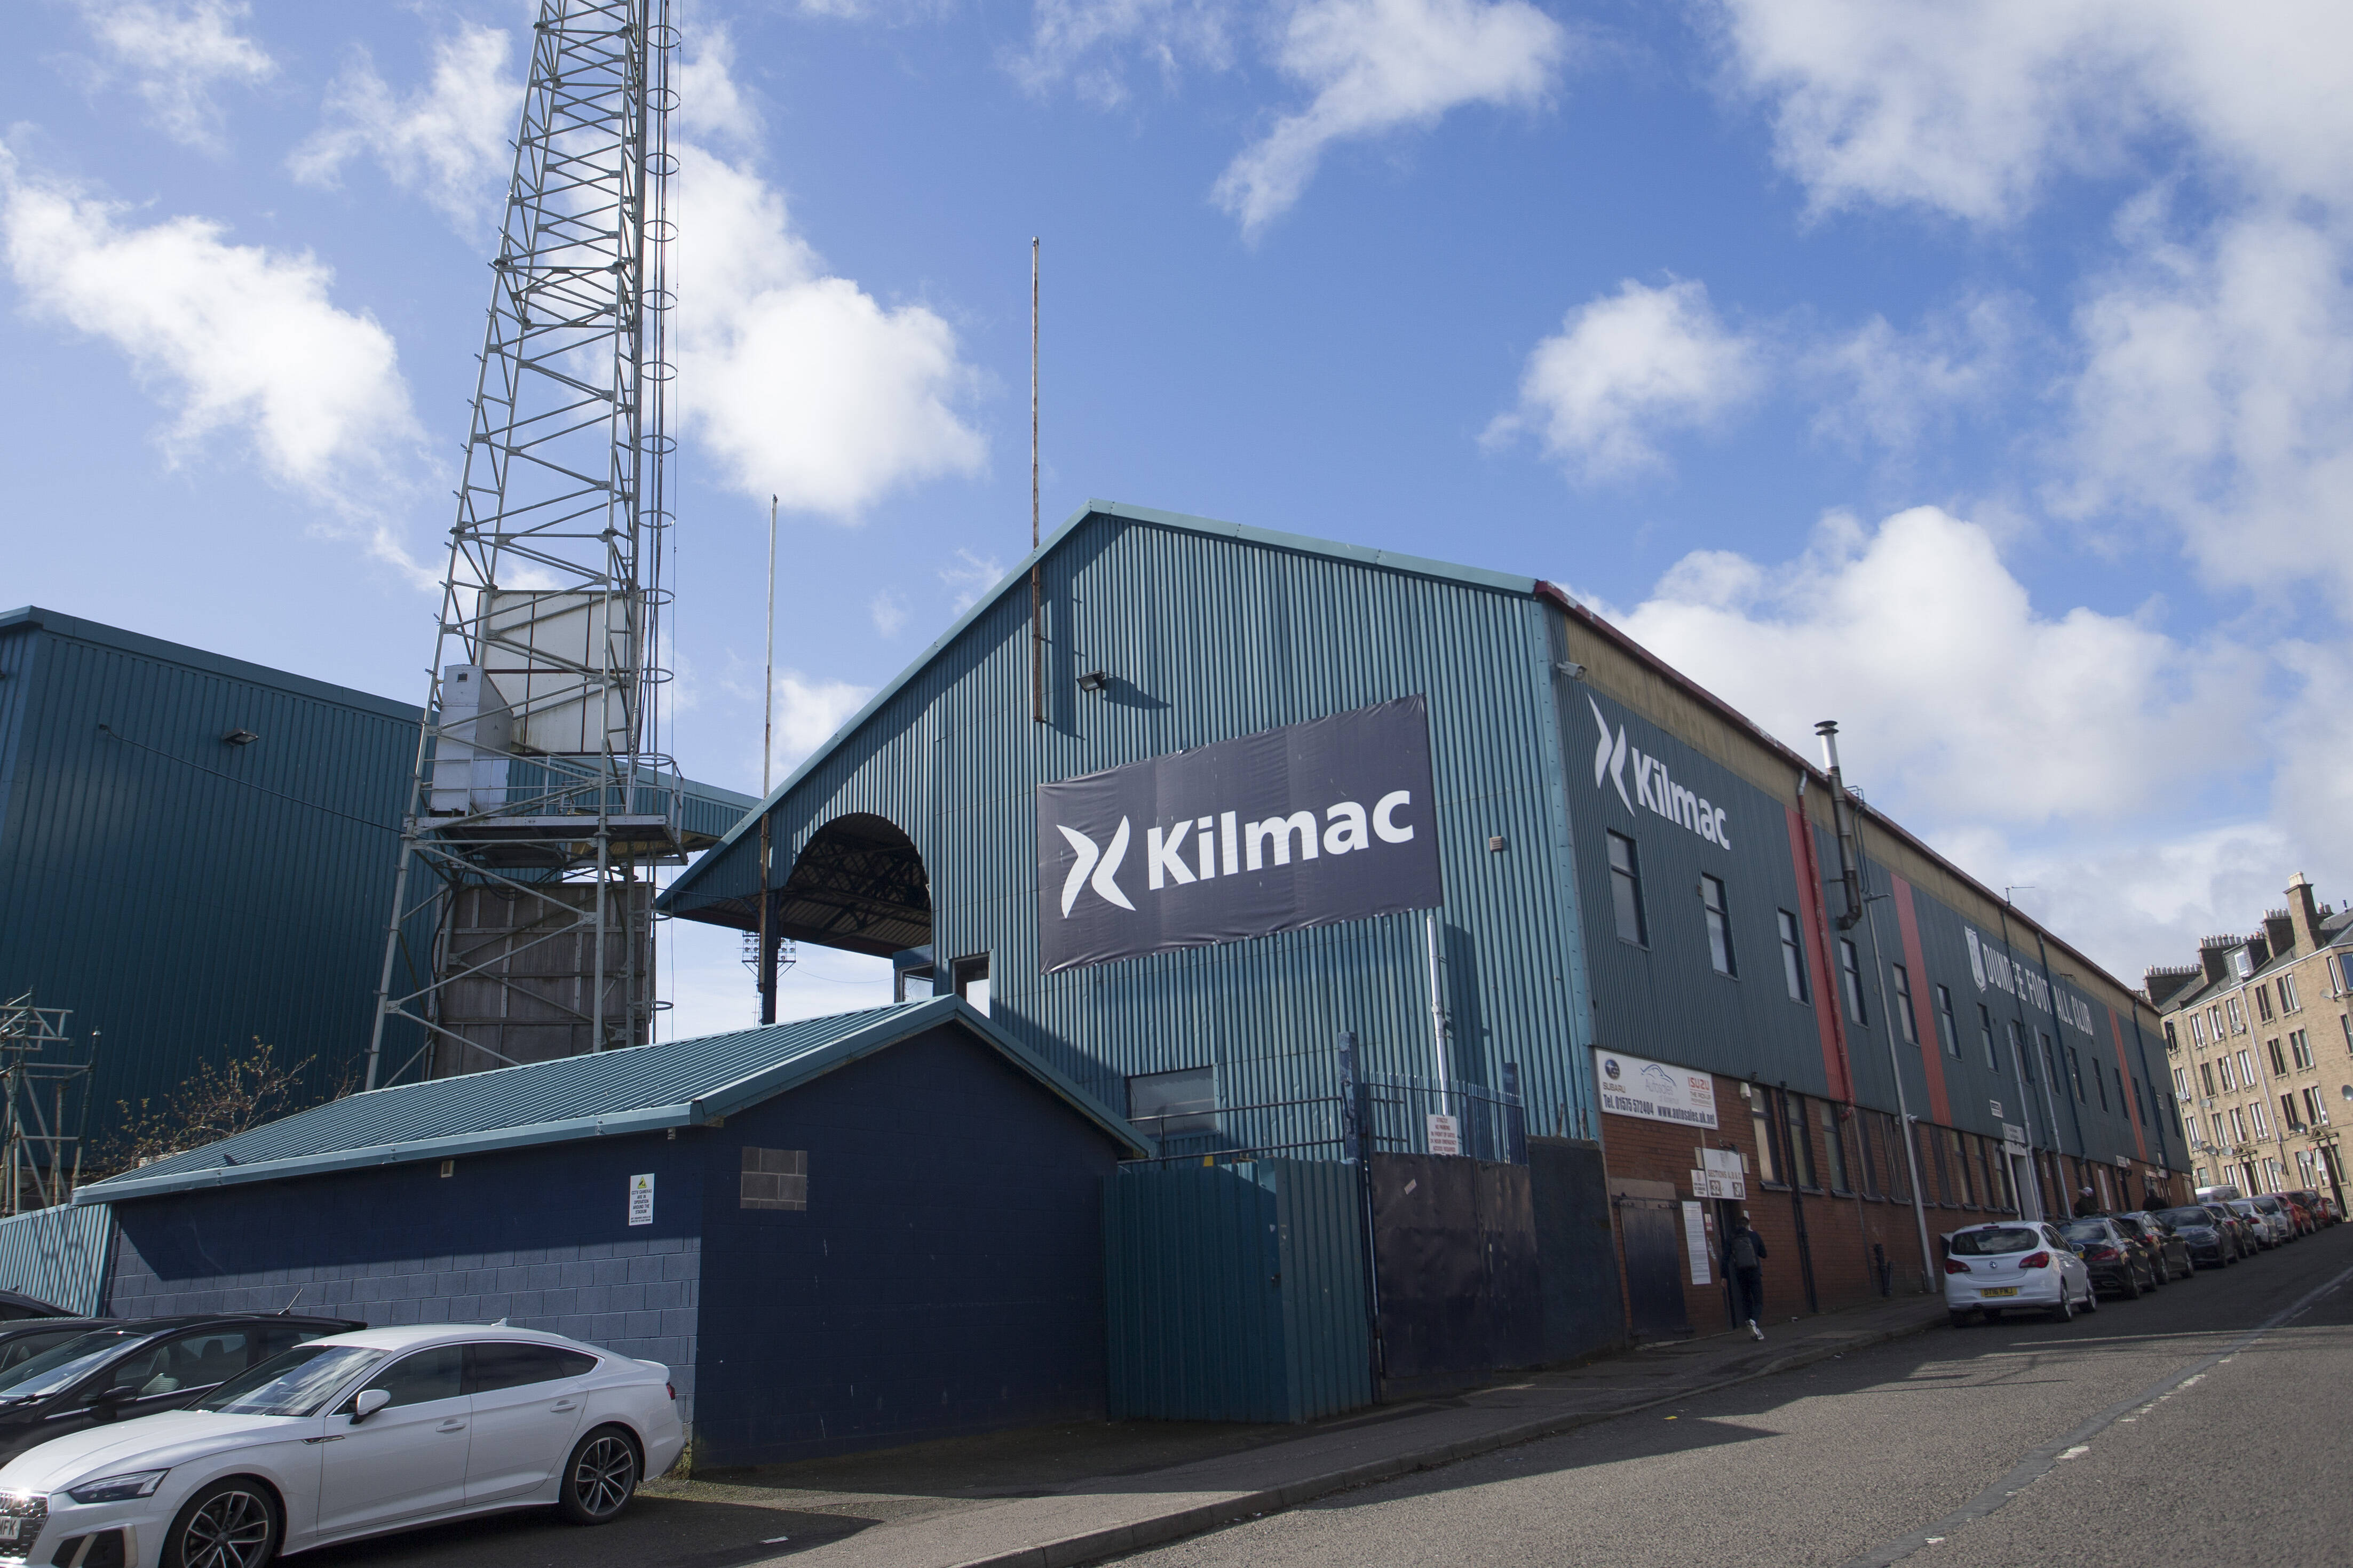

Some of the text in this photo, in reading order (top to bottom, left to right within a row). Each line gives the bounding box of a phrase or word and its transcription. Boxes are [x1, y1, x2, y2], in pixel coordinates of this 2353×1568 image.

[1631, 746, 1730, 850] Kilmac
[1147, 790, 1414, 890] Kilmac
[2025, 968, 2073, 1025] FOOTALL
[2071, 994, 2093, 1036] CLUB
[1603, 1081, 1626, 1093] SUBARU
[1645, 1078, 1674, 1095] Autosales
[1687, 1077, 1710, 1091] ISUZU
[1603, 1094, 1614, 1109] Tel.
[1615, 1096, 1632, 1111] 01575
[1633, 1100, 1654, 1116] 572404
[1657, 1105, 1716, 1125] www.autosales.uk.net
